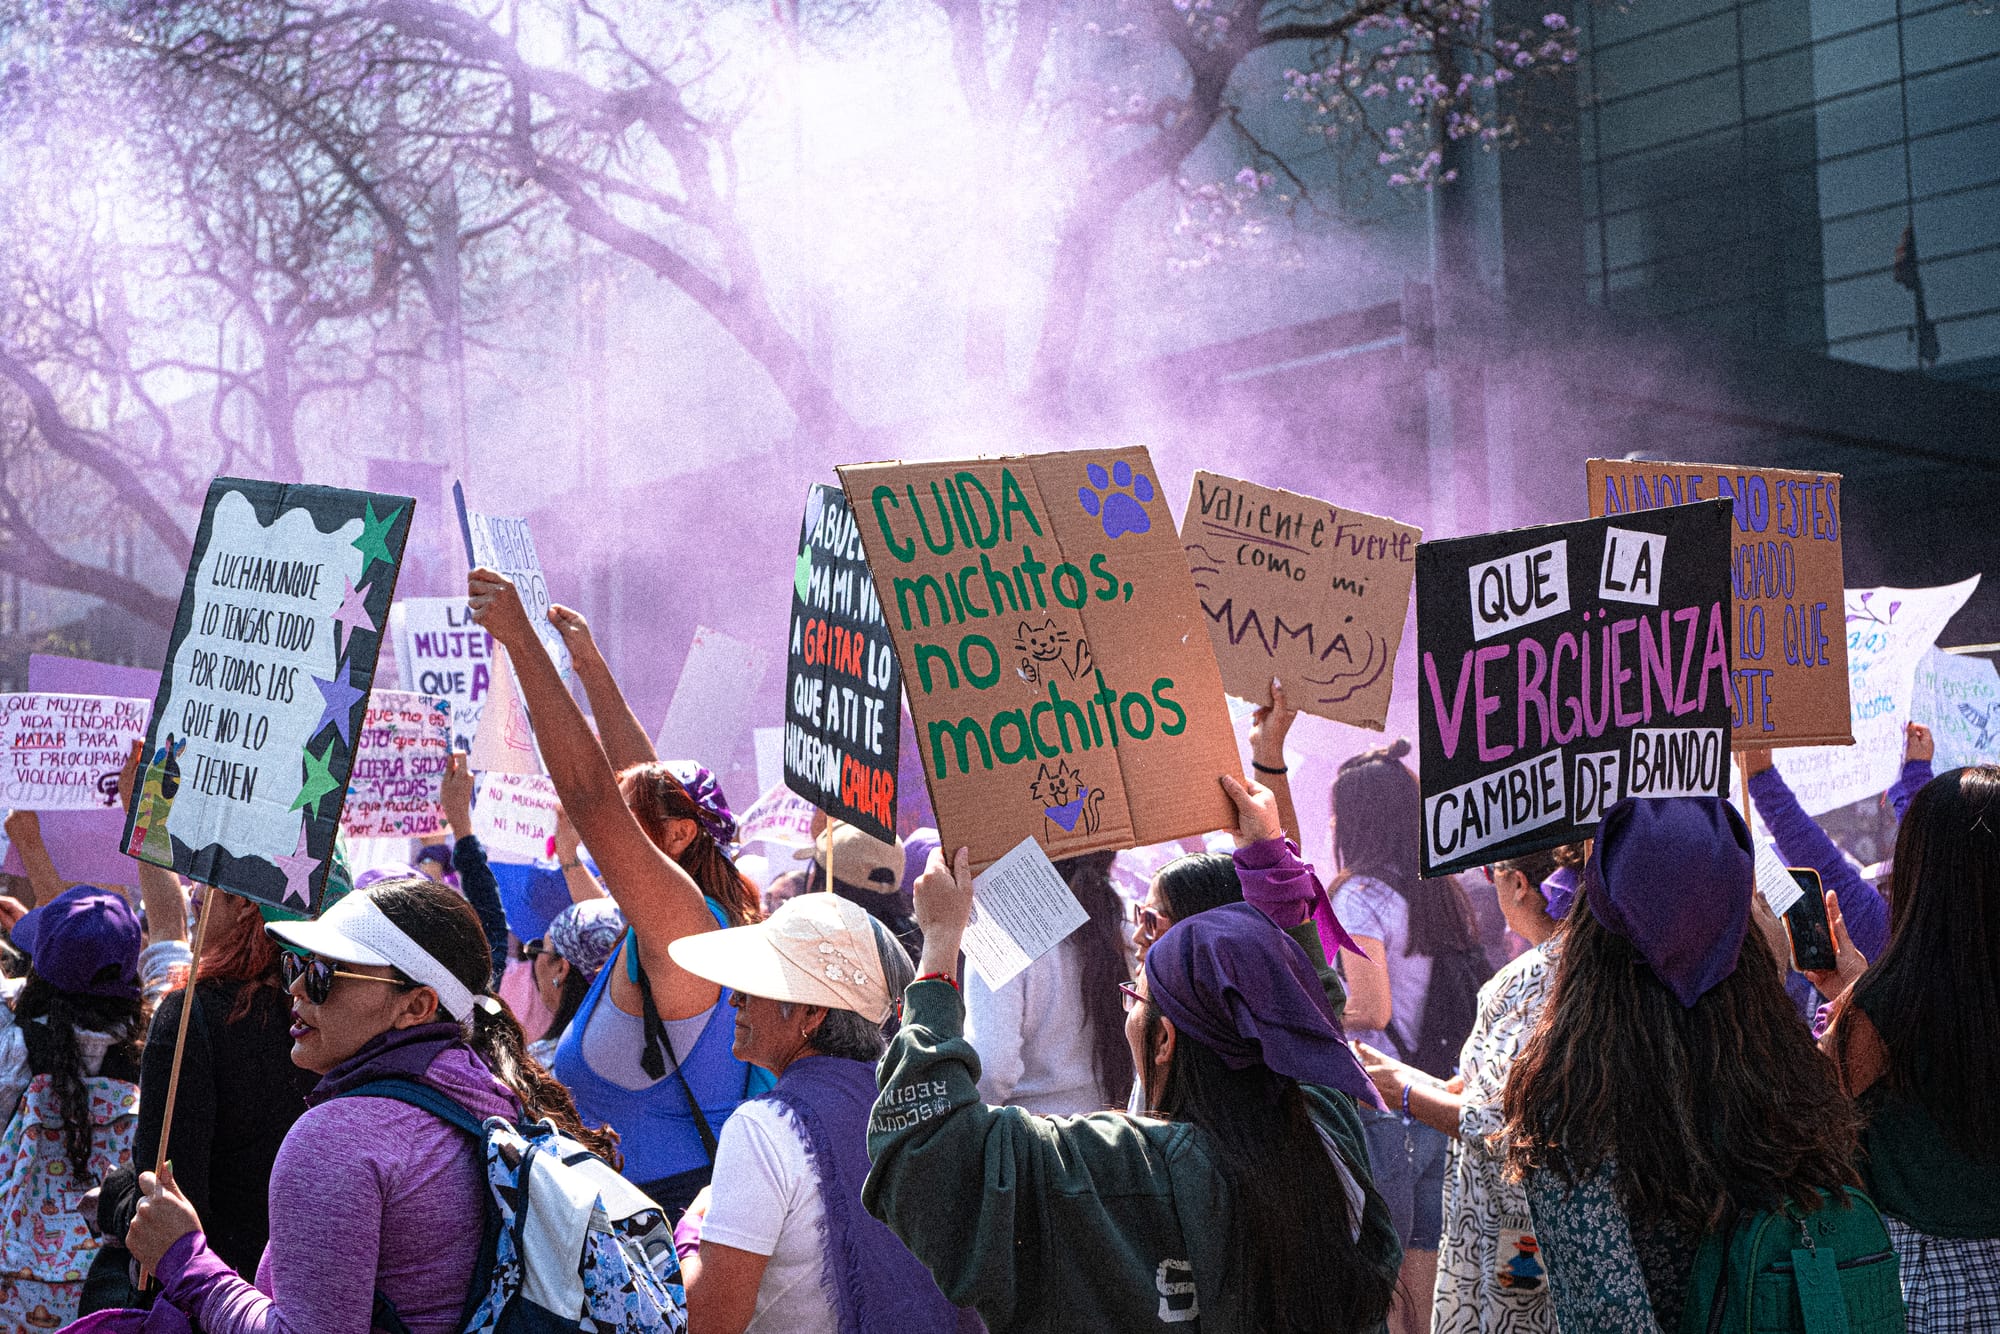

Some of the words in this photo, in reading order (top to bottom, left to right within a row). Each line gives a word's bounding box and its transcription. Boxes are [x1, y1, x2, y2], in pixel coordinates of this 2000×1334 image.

[872, 467, 1043, 563] CUIDA
[1718, 475, 1769, 533] NO
[1776, 477, 1837, 542] ESTÉS
[893, 545, 1134, 630] michitos,
[1332, 576, 1369, 597] mi
[1478, 550, 1558, 623] QUE
[1605, 537, 1651, 595] LA
[200, 601, 219, 636] LO
[222, 603, 275, 645] TENGAS
[276, 611, 315, 652] TODO
[791, 616, 801, 656] A
[804, 618, 865, 680] GRITAR
[868, 640, 892, 691] LO
[1740, 604, 1766, 661] LO
[1783, 602, 1830, 668] QUE
[189, 649, 218, 690] POR
[219, 655, 265, 697] TODAS
[266, 663, 299, 704] LAS
[419, 670, 466, 695] QUE
[914, 634, 1000, 694] no
[1424, 601, 1732, 762] VERGÜENZA
[20, 715, 52, 729] VIDA
[46, 698, 101, 713] MUJER
[182, 699, 214, 739] QUE
[215, 708, 239, 744] NO
[242, 712, 269, 751] LO
[400, 711, 422, 723] no
[794, 673, 823, 728] QUE
[864, 695, 884, 756] TE
[928, 669, 1187, 780] machitos
[1731, 668, 1775, 732] STE
[10, 751, 31, 766] TE
[15, 732, 66, 748] MATAR
[78, 732, 118, 748] PARA
[192, 753, 258, 804] TIENEN
[489, 787, 502, 801] NO
[786, 721, 841, 799] HICIERON
[841, 753, 895, 830] CALLAR
[1433, 756, 1564, 856] CAMBIE
[1576, 756, 1617, 822] DE
[1631, 731, 1719, 794] BANDO
[493, 817, 507, 831] NI
[878, 1081, 947, 1108] REGIM
